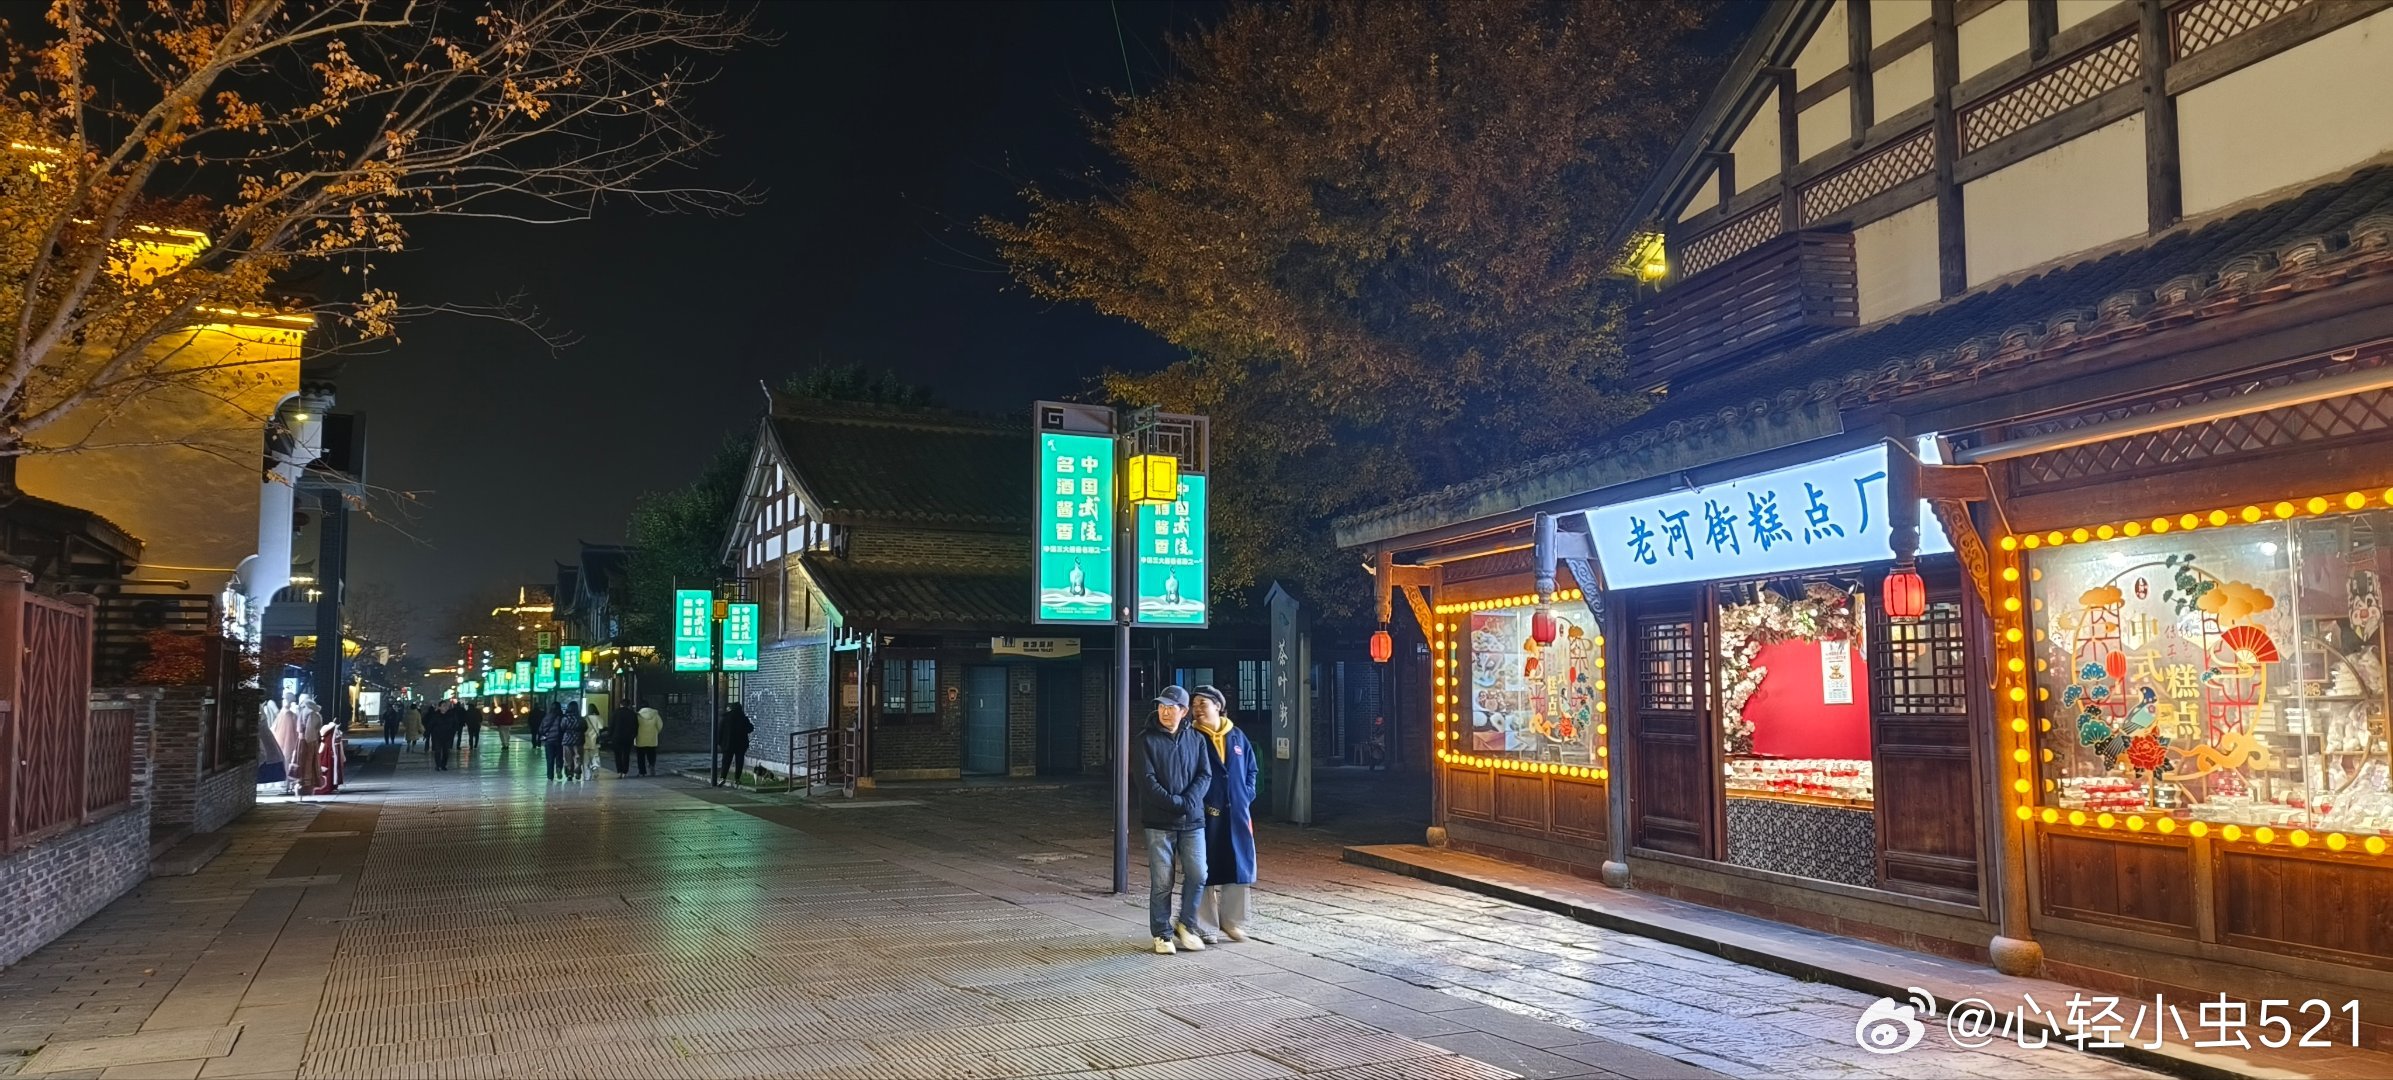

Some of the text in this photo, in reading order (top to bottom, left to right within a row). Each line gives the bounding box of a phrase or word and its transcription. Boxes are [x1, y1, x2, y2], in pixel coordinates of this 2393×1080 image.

[1078, 455, 1100, 541] 中国武陵
[1626, 470, 1887, 565] 老河街糕点厂
[1277, 638, 1289, 729] 茶叶街
[2129, 612, 2165, 683] 中式
[2166, 663, 2202, 740] 糕点
